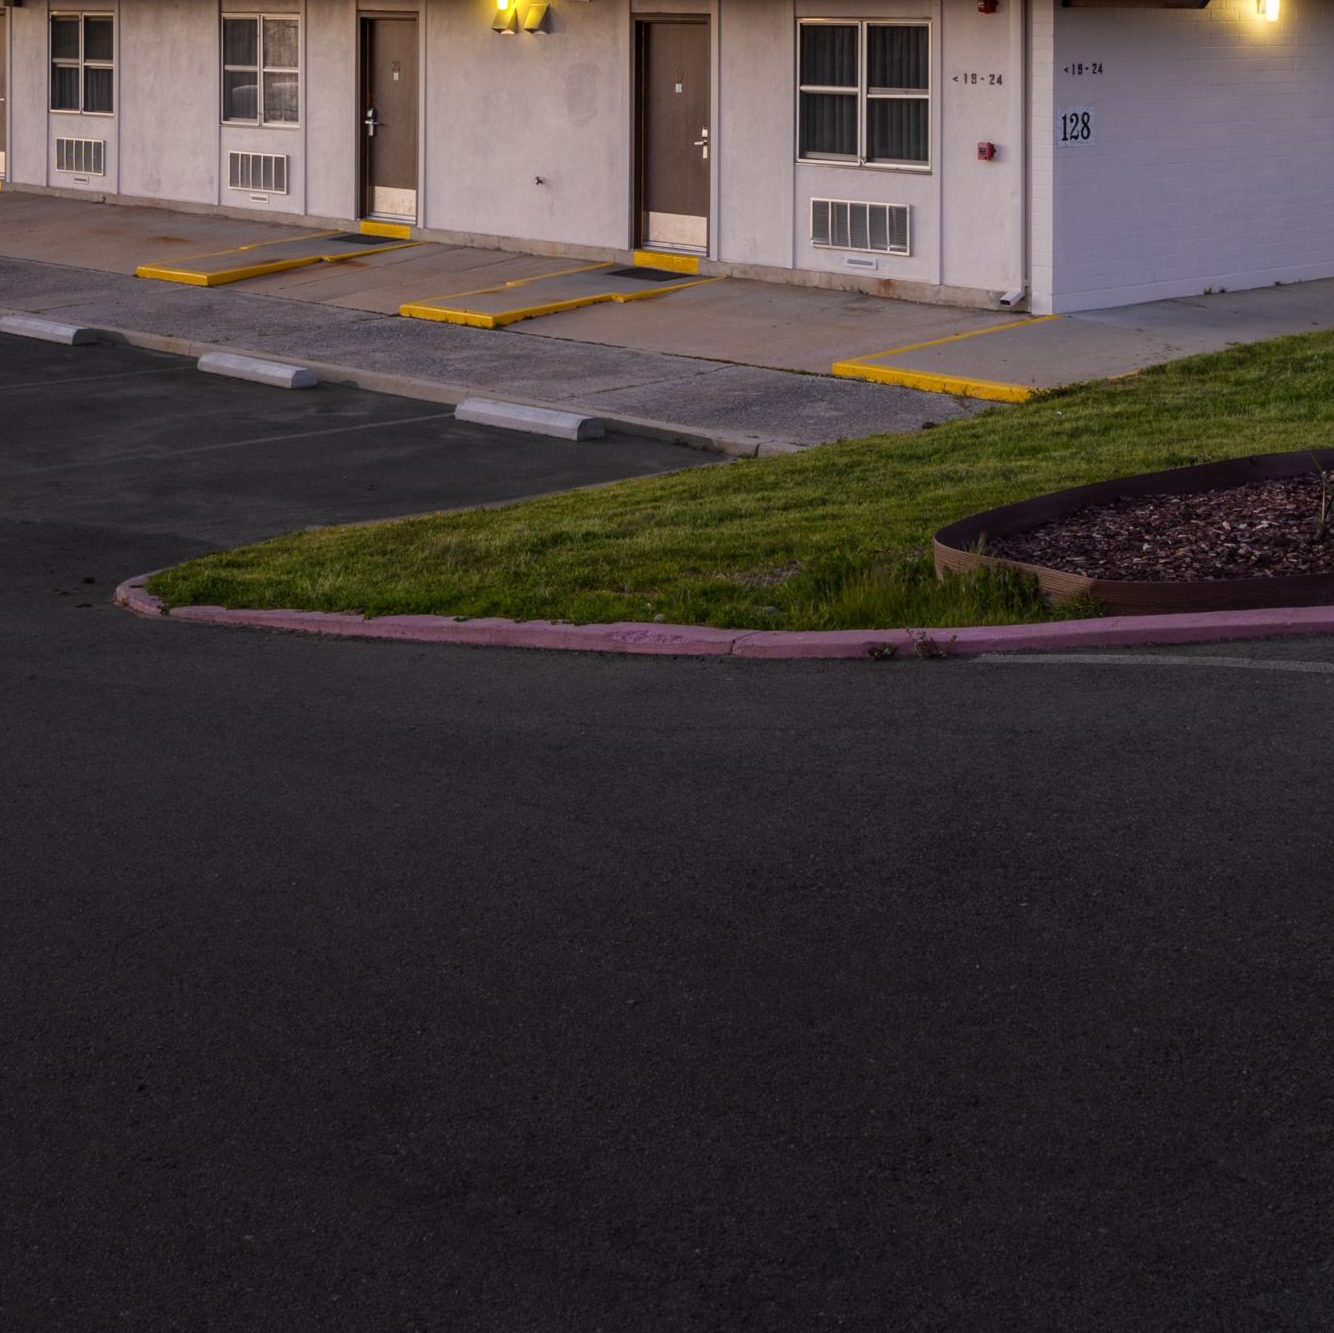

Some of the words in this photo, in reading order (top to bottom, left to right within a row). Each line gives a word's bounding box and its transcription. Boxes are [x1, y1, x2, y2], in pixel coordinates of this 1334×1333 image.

[1091, 62, 1103, 75] 24
[989, 73, 1003, 86] 24
[1061, 111, 1091, 141] 128
